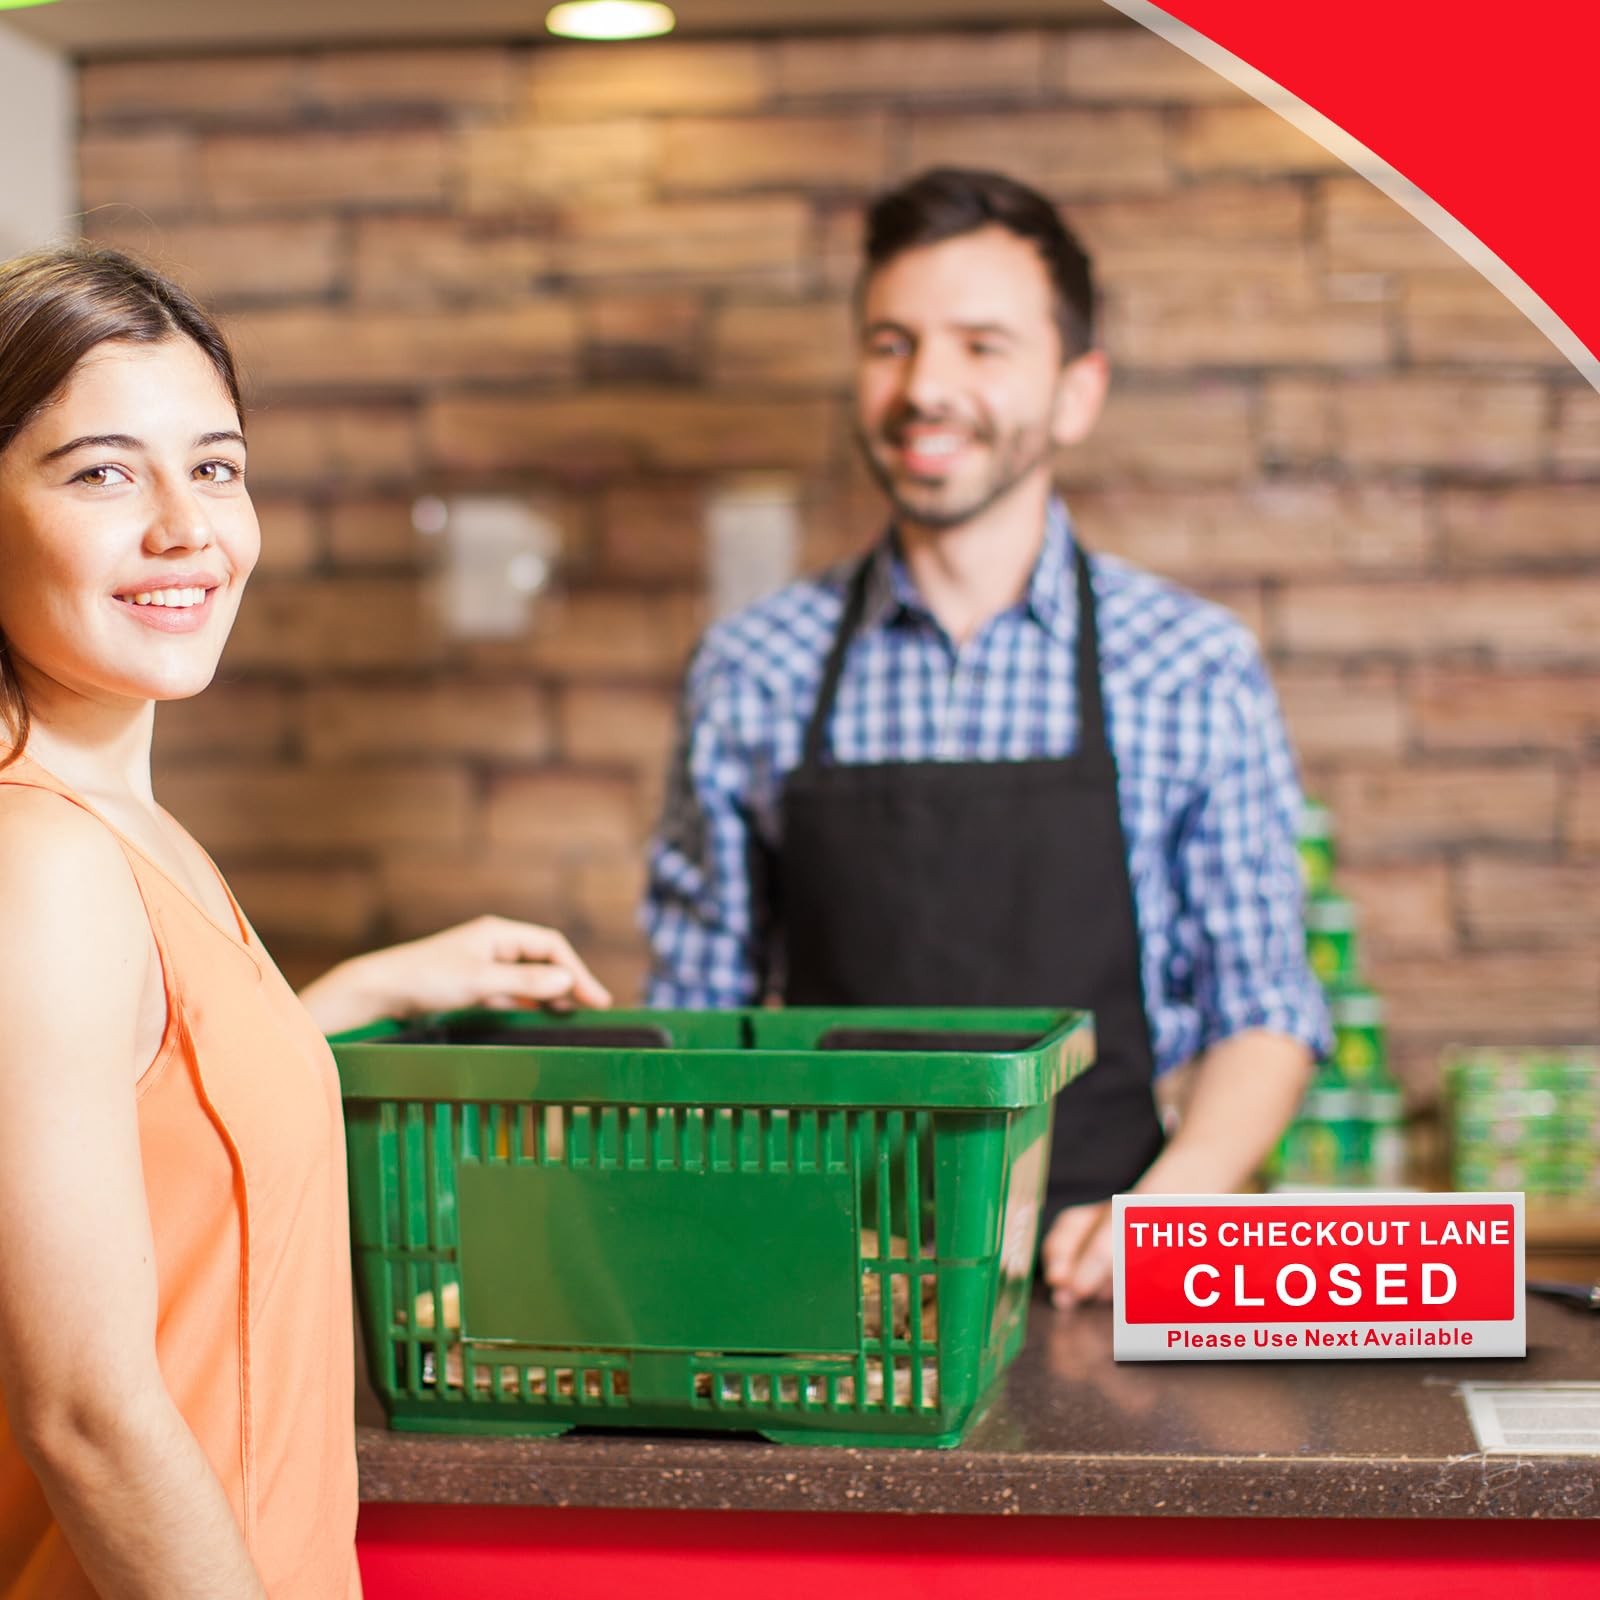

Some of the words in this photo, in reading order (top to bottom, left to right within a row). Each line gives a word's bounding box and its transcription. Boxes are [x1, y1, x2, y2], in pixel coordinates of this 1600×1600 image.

[1130, 1222, 1208, 1248] THIS
[1217, 1221, 1410, 1247] CHECKOUT
[1420, 1220, 1510, 1246] LANE
[1183, 1262, 1457, 1307] CLOSED
[1167, 1329, 1246, 1348] Please
[1253, 1329, 1298, 1348] Use
[1305, 1328, 1358, 1347] Next
[1364, 1327, 1473, 1346] Available
